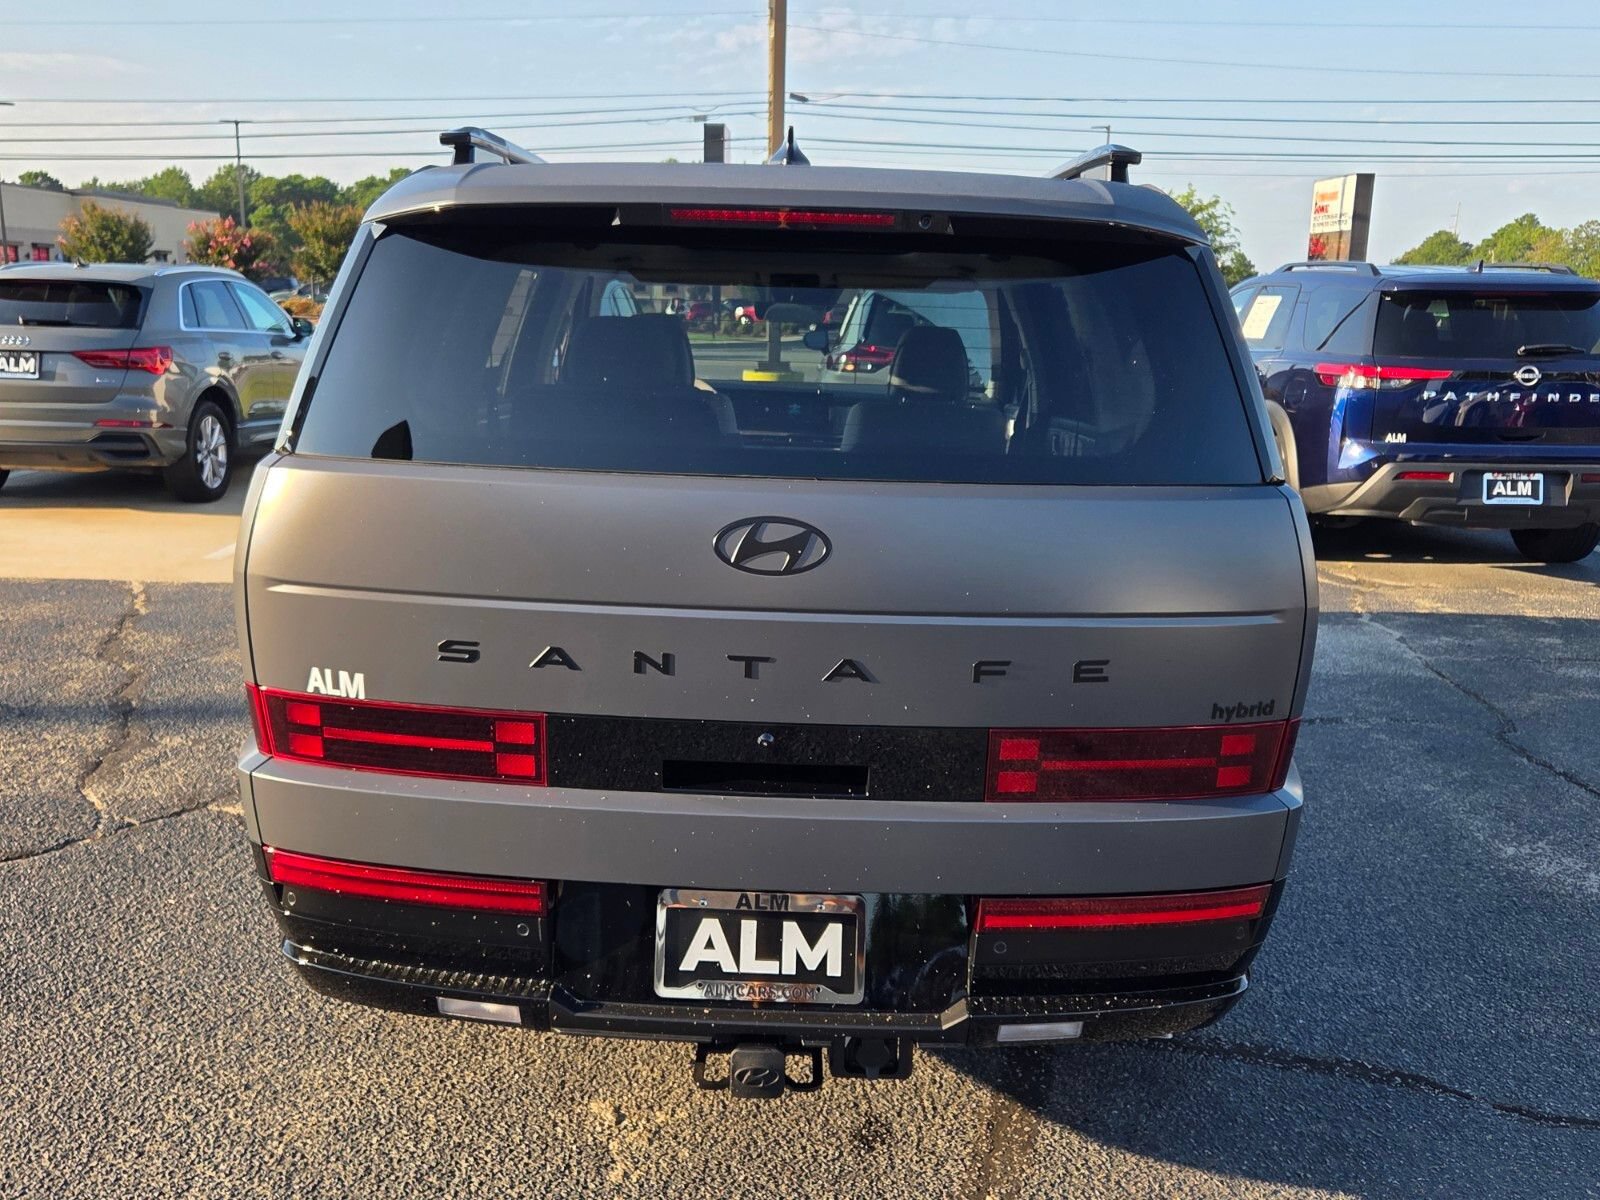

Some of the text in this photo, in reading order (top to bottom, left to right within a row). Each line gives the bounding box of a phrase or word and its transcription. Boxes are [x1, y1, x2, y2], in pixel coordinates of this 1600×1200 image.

[0, 356, 35, 373] ALM
[1385, 433, 1407, 444] ALM
[1492, 480, 1532, 496] ALM
[437, 639, 1110, 684] SANTA FE
[306, 666, 366, 699] ALM
[1211, 700, 1275, 721] hybrid
[735, 892, 791, 912] ALM
[678, 917, 843, 977] ALM
[703, 982, 816, 1000] ALMCARS.COM
